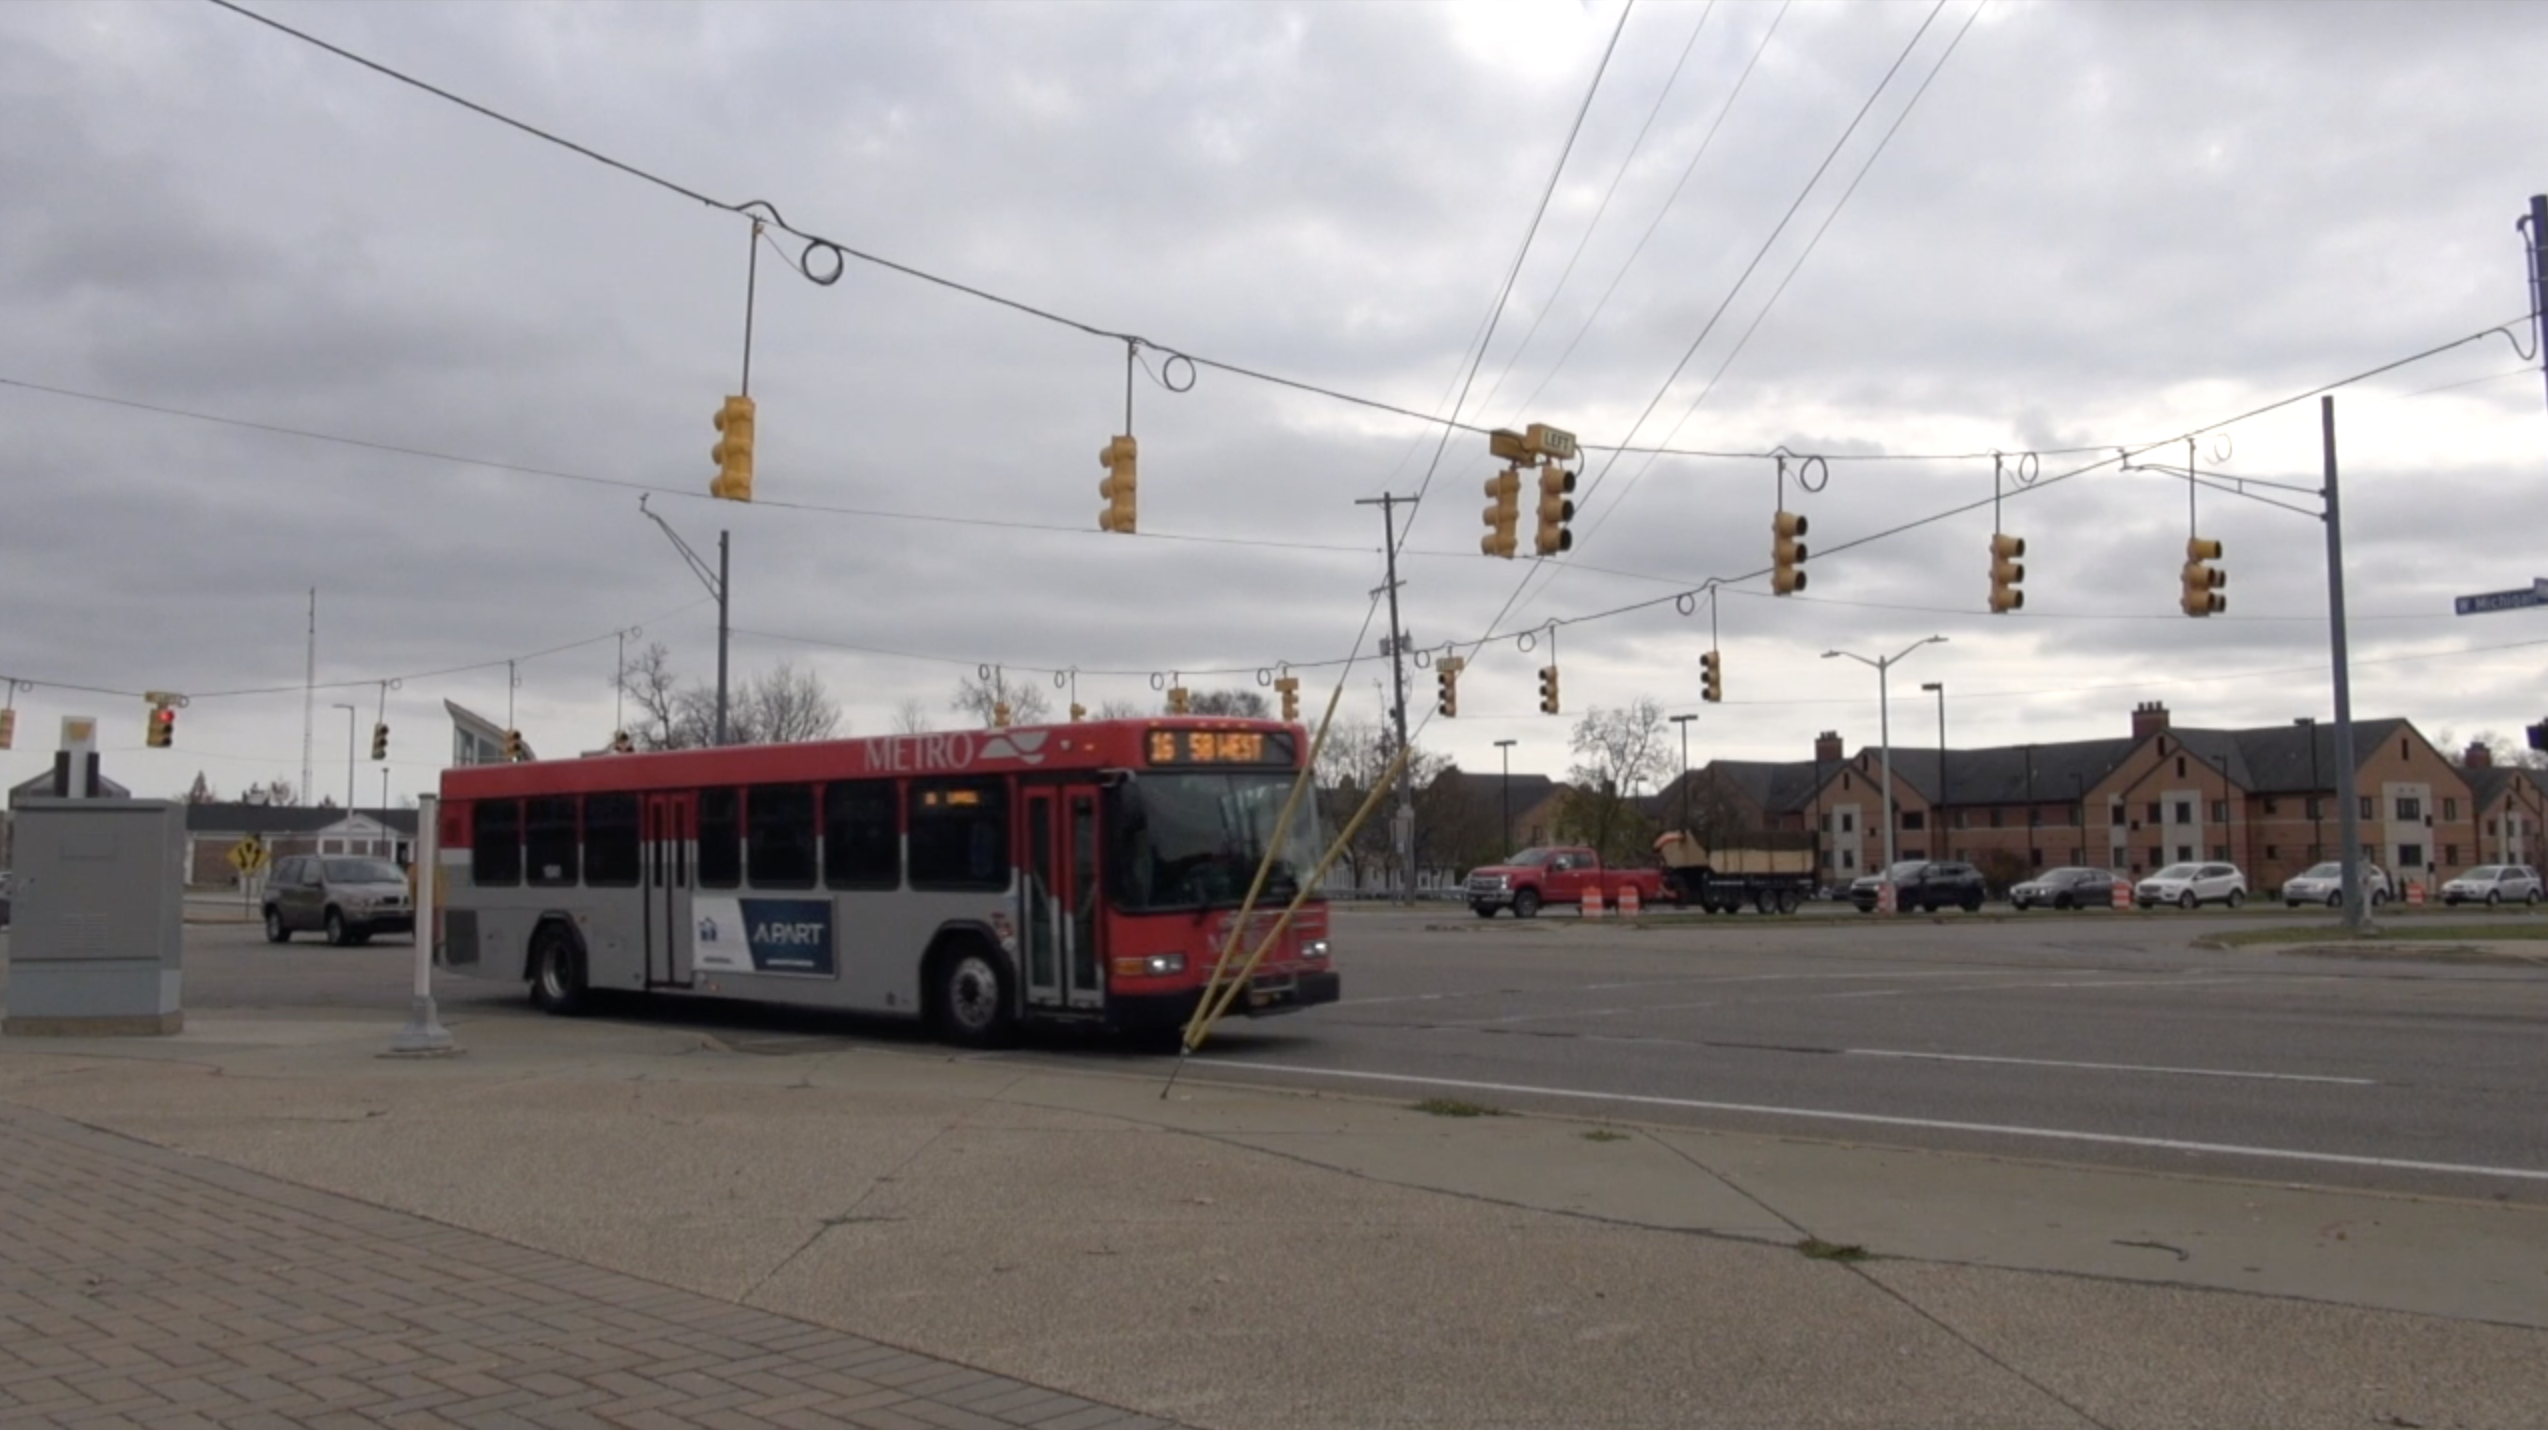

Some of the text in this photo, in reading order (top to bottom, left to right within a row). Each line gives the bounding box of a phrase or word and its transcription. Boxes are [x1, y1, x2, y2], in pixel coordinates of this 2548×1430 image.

[1544, 430, 1570, 450] LEFT
[865, 731, 974, 771] METRO
[1150, 731, 1175, 762] 16
[1216, 732, 1264, 762] WEST
